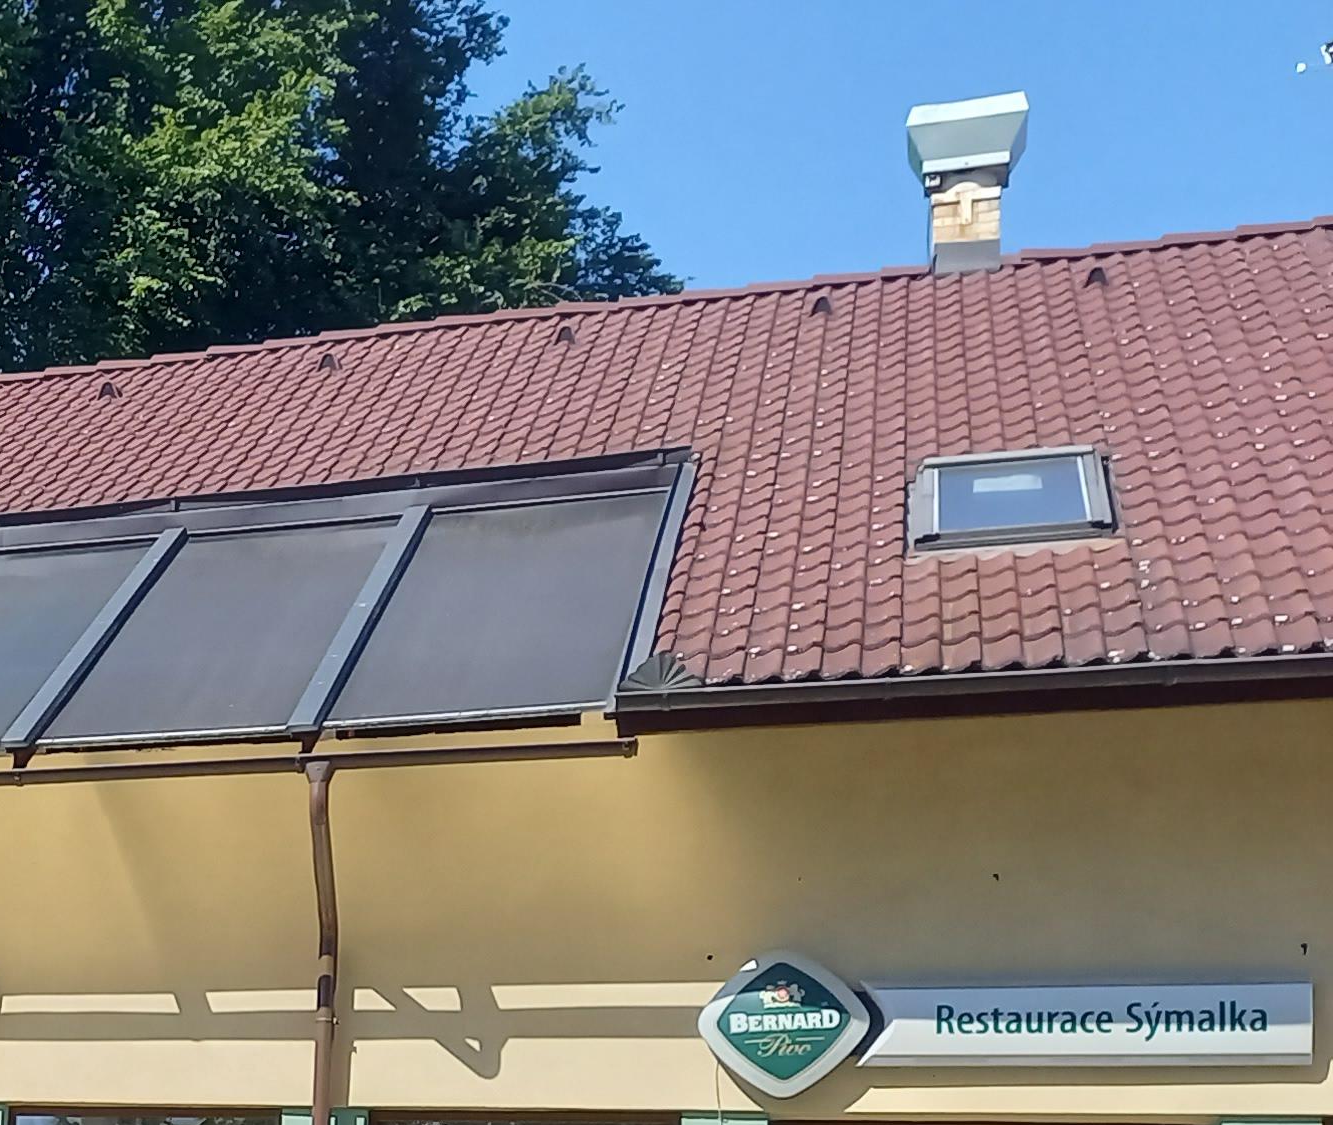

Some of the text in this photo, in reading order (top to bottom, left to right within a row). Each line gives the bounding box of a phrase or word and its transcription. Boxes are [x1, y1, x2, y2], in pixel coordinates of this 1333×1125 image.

[728, 1009, 841, 1035] BERNARD
[936, 1000, 1268, 1042] Restaurace Sýmalka
